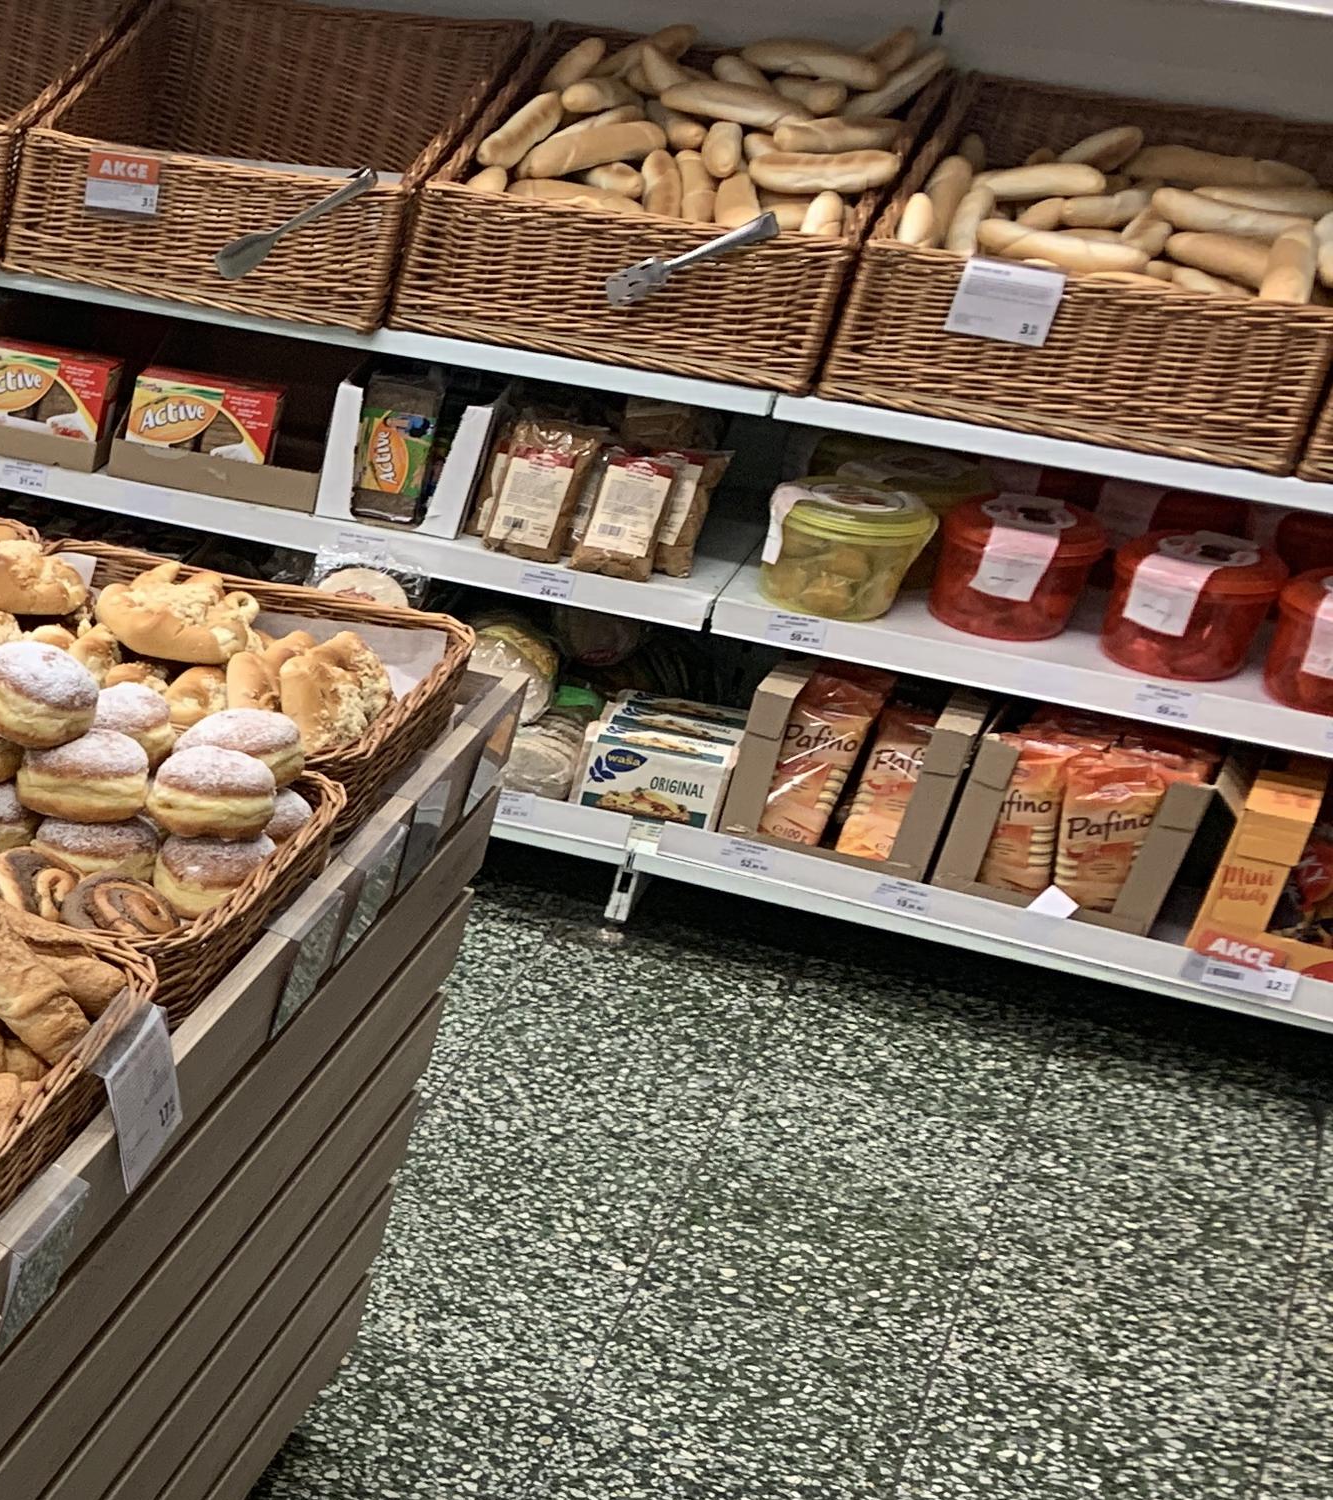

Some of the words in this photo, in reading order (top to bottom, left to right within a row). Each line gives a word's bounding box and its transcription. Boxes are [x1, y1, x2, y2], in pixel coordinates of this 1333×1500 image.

[99, 158, 150, 181] AKCE
[141, 399, 206, 433] Active
[374, 428, 396, 485] Active
[784, 724, 859, 757] Pafino
[606, 752, 644, 769] wasa
[649, 775, 705, 800] ORIGINAL
[1207, 938, 1275, 967] AKCE
